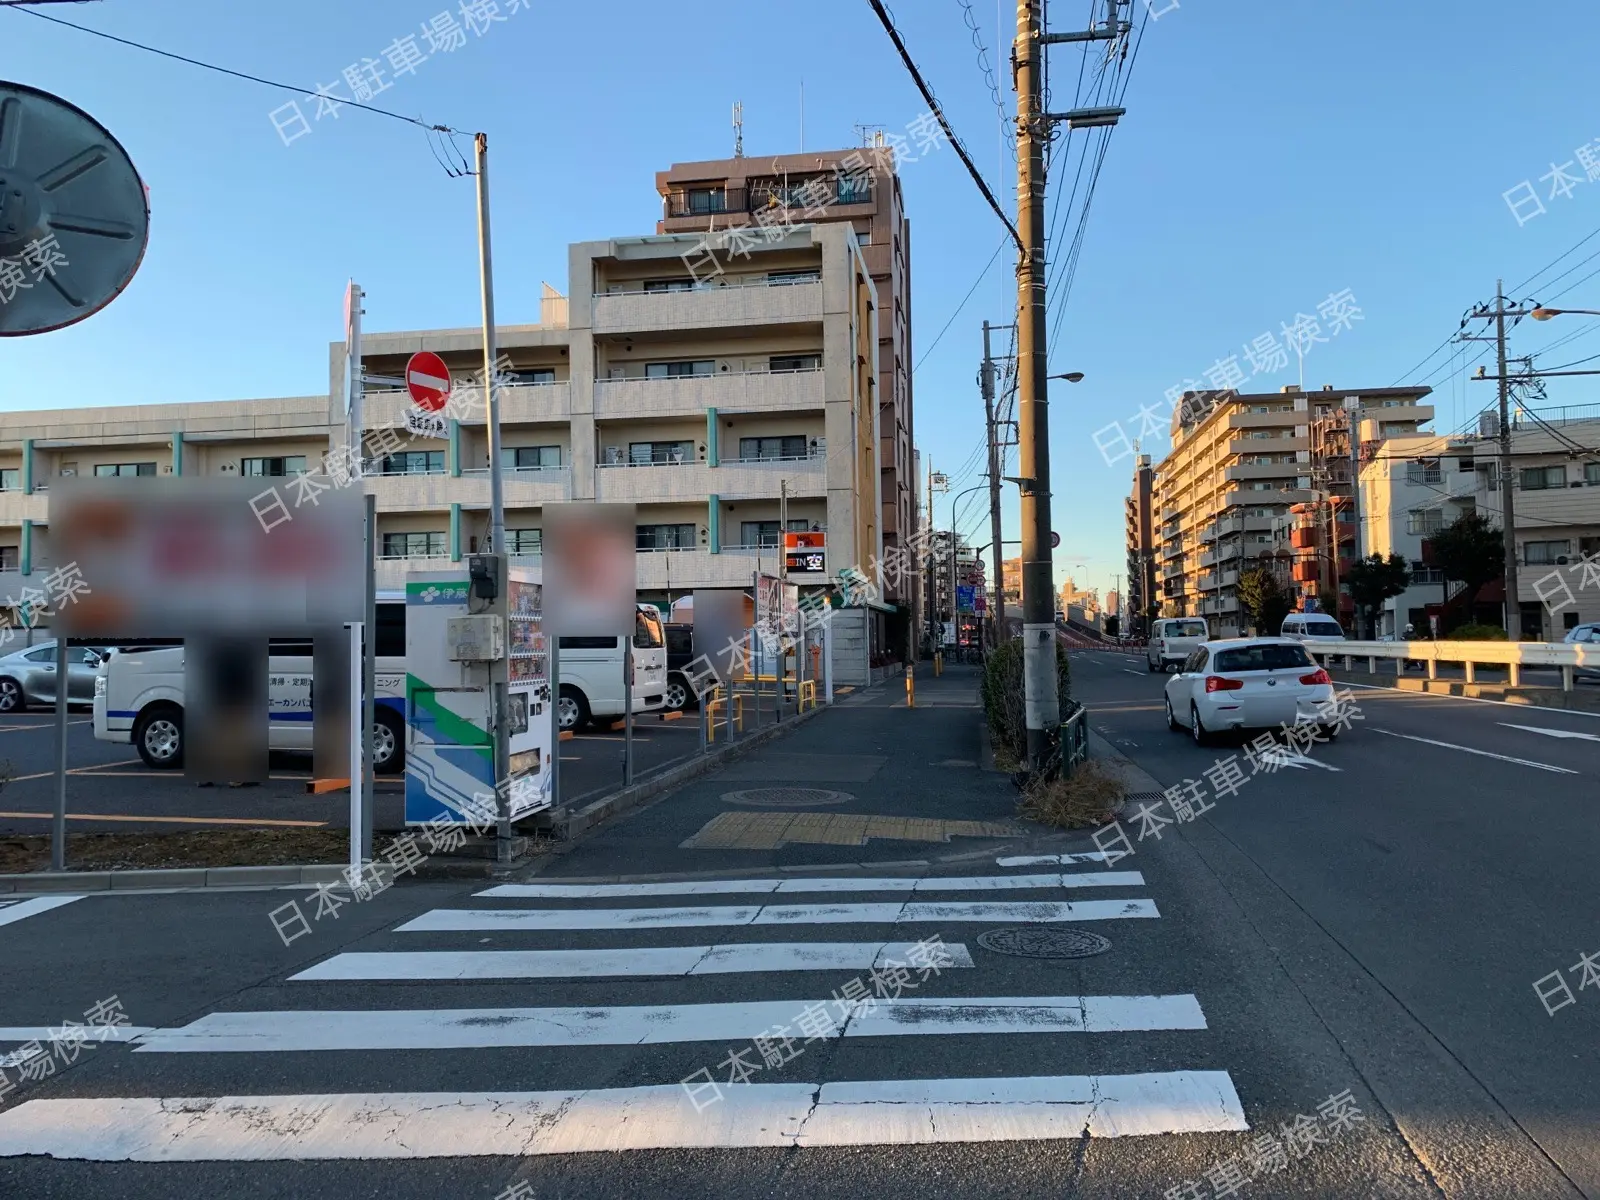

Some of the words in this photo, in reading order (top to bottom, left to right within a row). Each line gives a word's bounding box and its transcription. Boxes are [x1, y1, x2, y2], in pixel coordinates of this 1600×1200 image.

[269, 677, 310, 687] 清掃・定期
